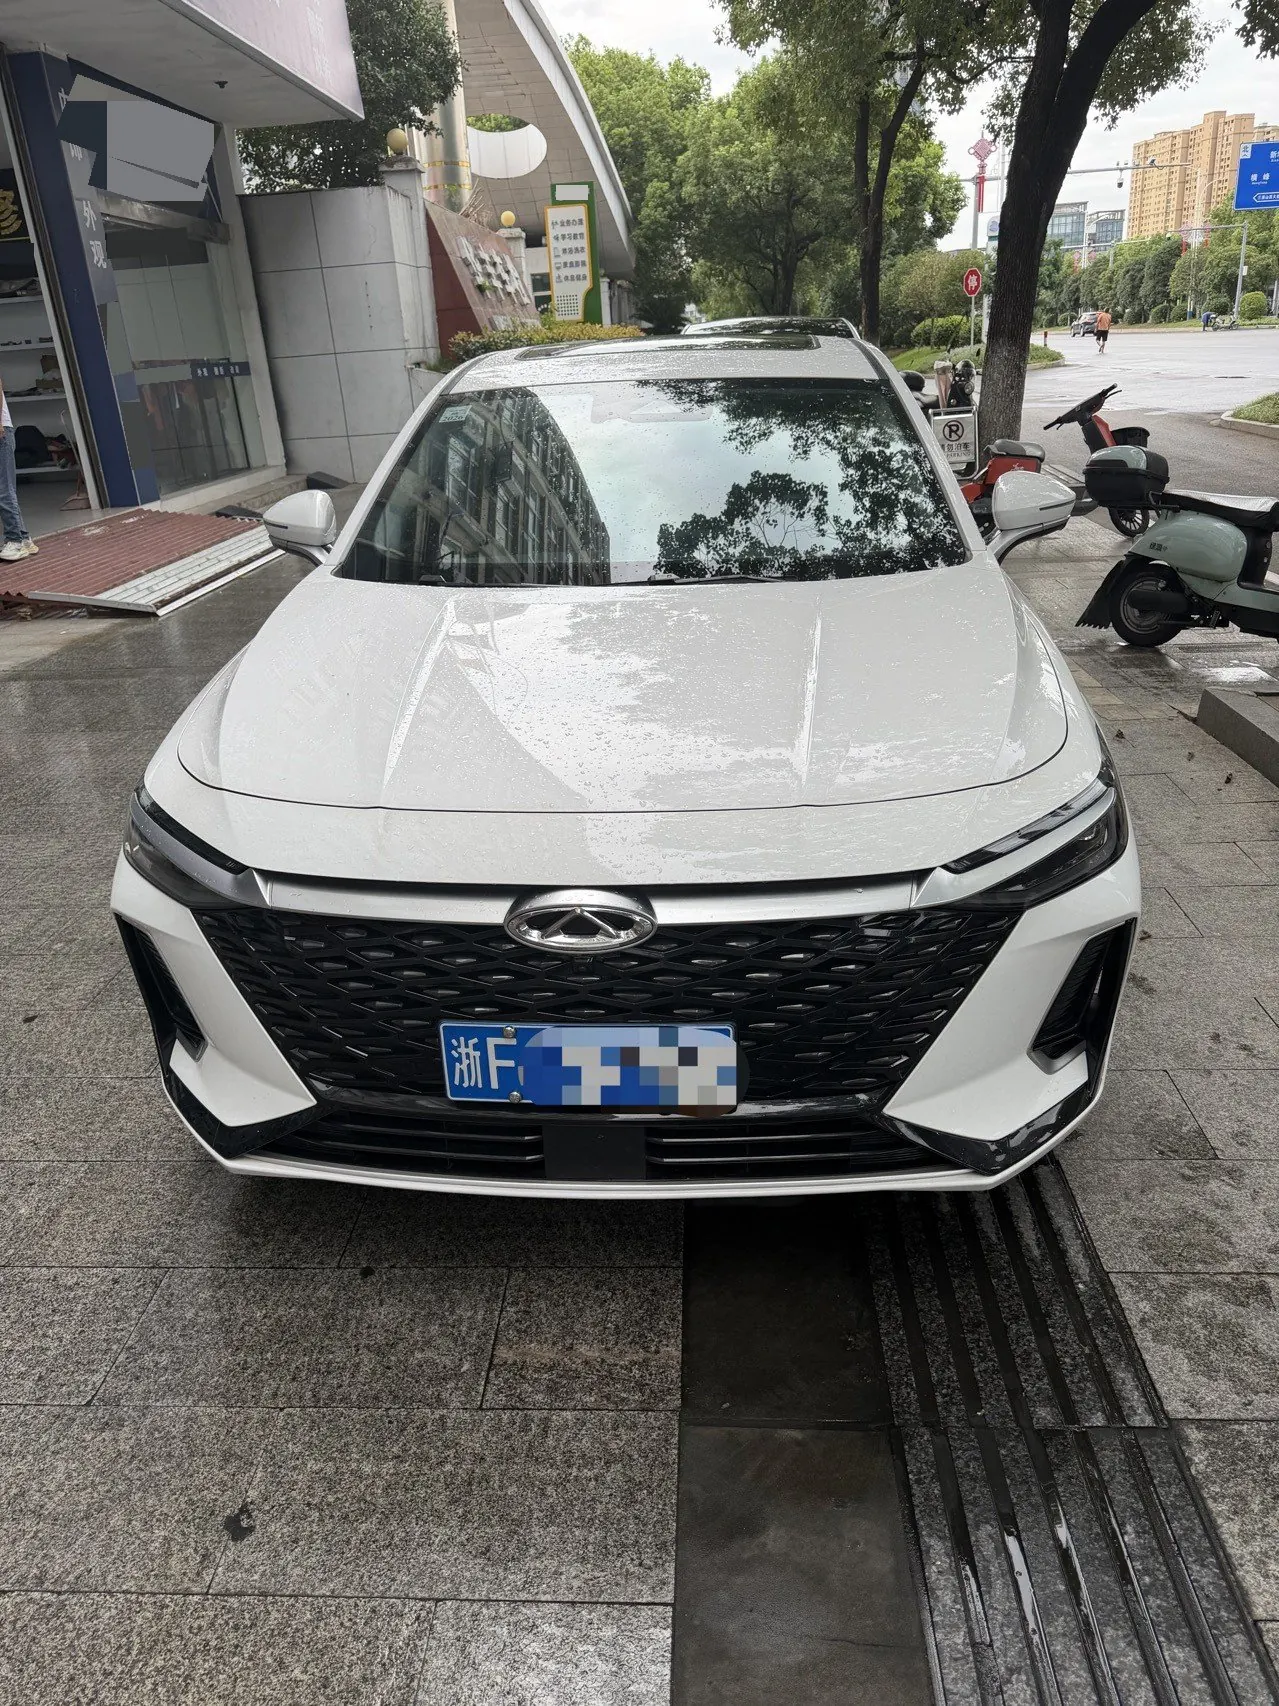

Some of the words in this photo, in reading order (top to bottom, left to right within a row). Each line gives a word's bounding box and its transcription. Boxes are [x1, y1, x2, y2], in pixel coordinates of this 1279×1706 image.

[1270, 151, 1279, 159] 新
[1251, 173, 1270, 181] 横峰
[560, 218, 584, 227] 业务办理
[561, 232, 585, 241] 学习教育
[968, 274, 978, 291] 停
